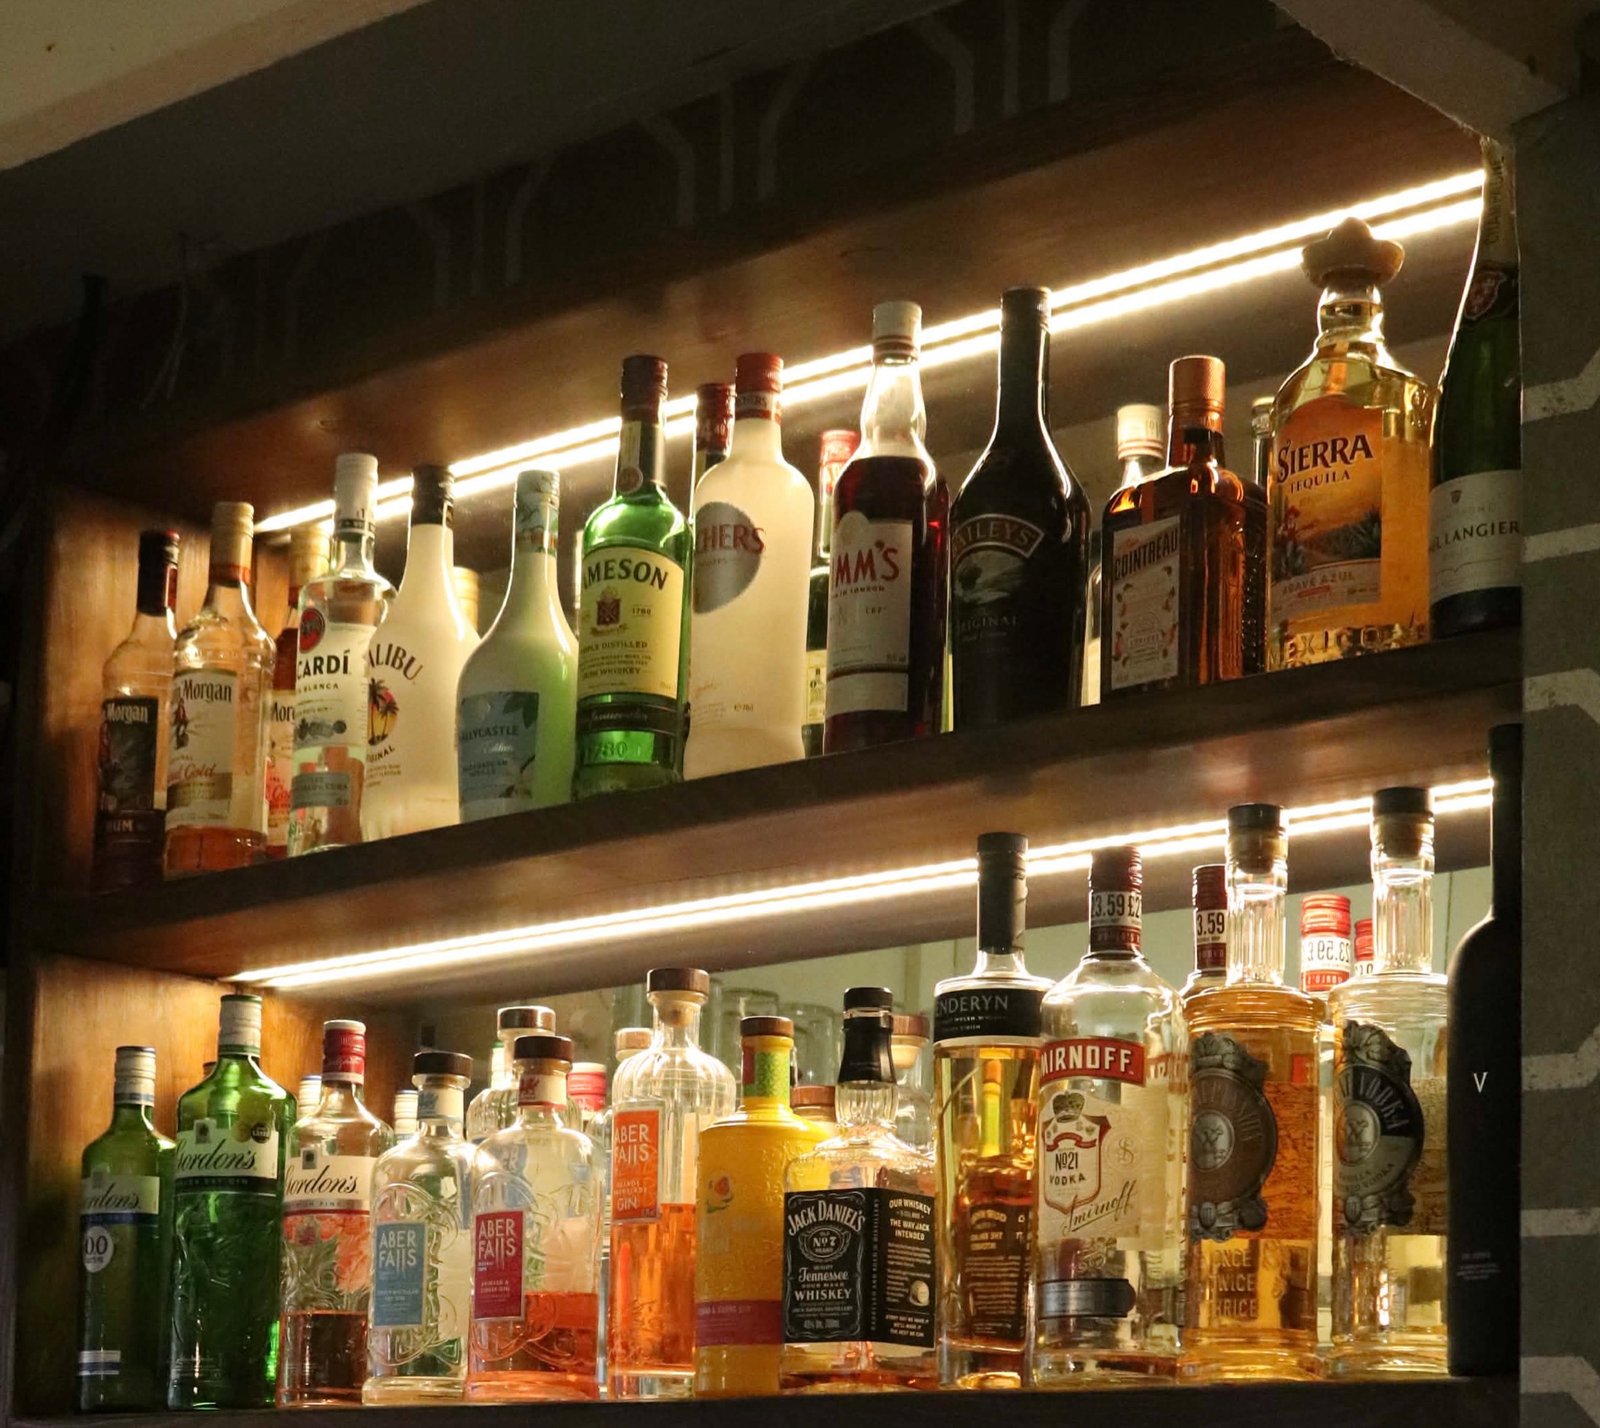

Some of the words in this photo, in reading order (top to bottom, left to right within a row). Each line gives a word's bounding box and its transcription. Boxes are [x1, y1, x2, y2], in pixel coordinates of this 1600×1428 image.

[1277, 433, 1374, 484] SIERRA
[1290, 469, 1351, 494] TEQUILA
[1115, 528, 1178, 581] COINTREAU
[183, 679, 232, 703] Morgan
[107, 702, 149, 725] Morgan
[1473, 1071, 1488, 1094] V
[1049, 1172, 1087, 1187] VODKA
[478, 1218, 517, 1241] ABER
[788, 1205, 817, 1237] JACK
[818, 1199, 866, 1233] DANIEL'S
[379, 1229, 417, 1249] ABER
[798, 1267, 849, 1283] Tennessee
[794, 1288, 853, 1301] WHISKEY
